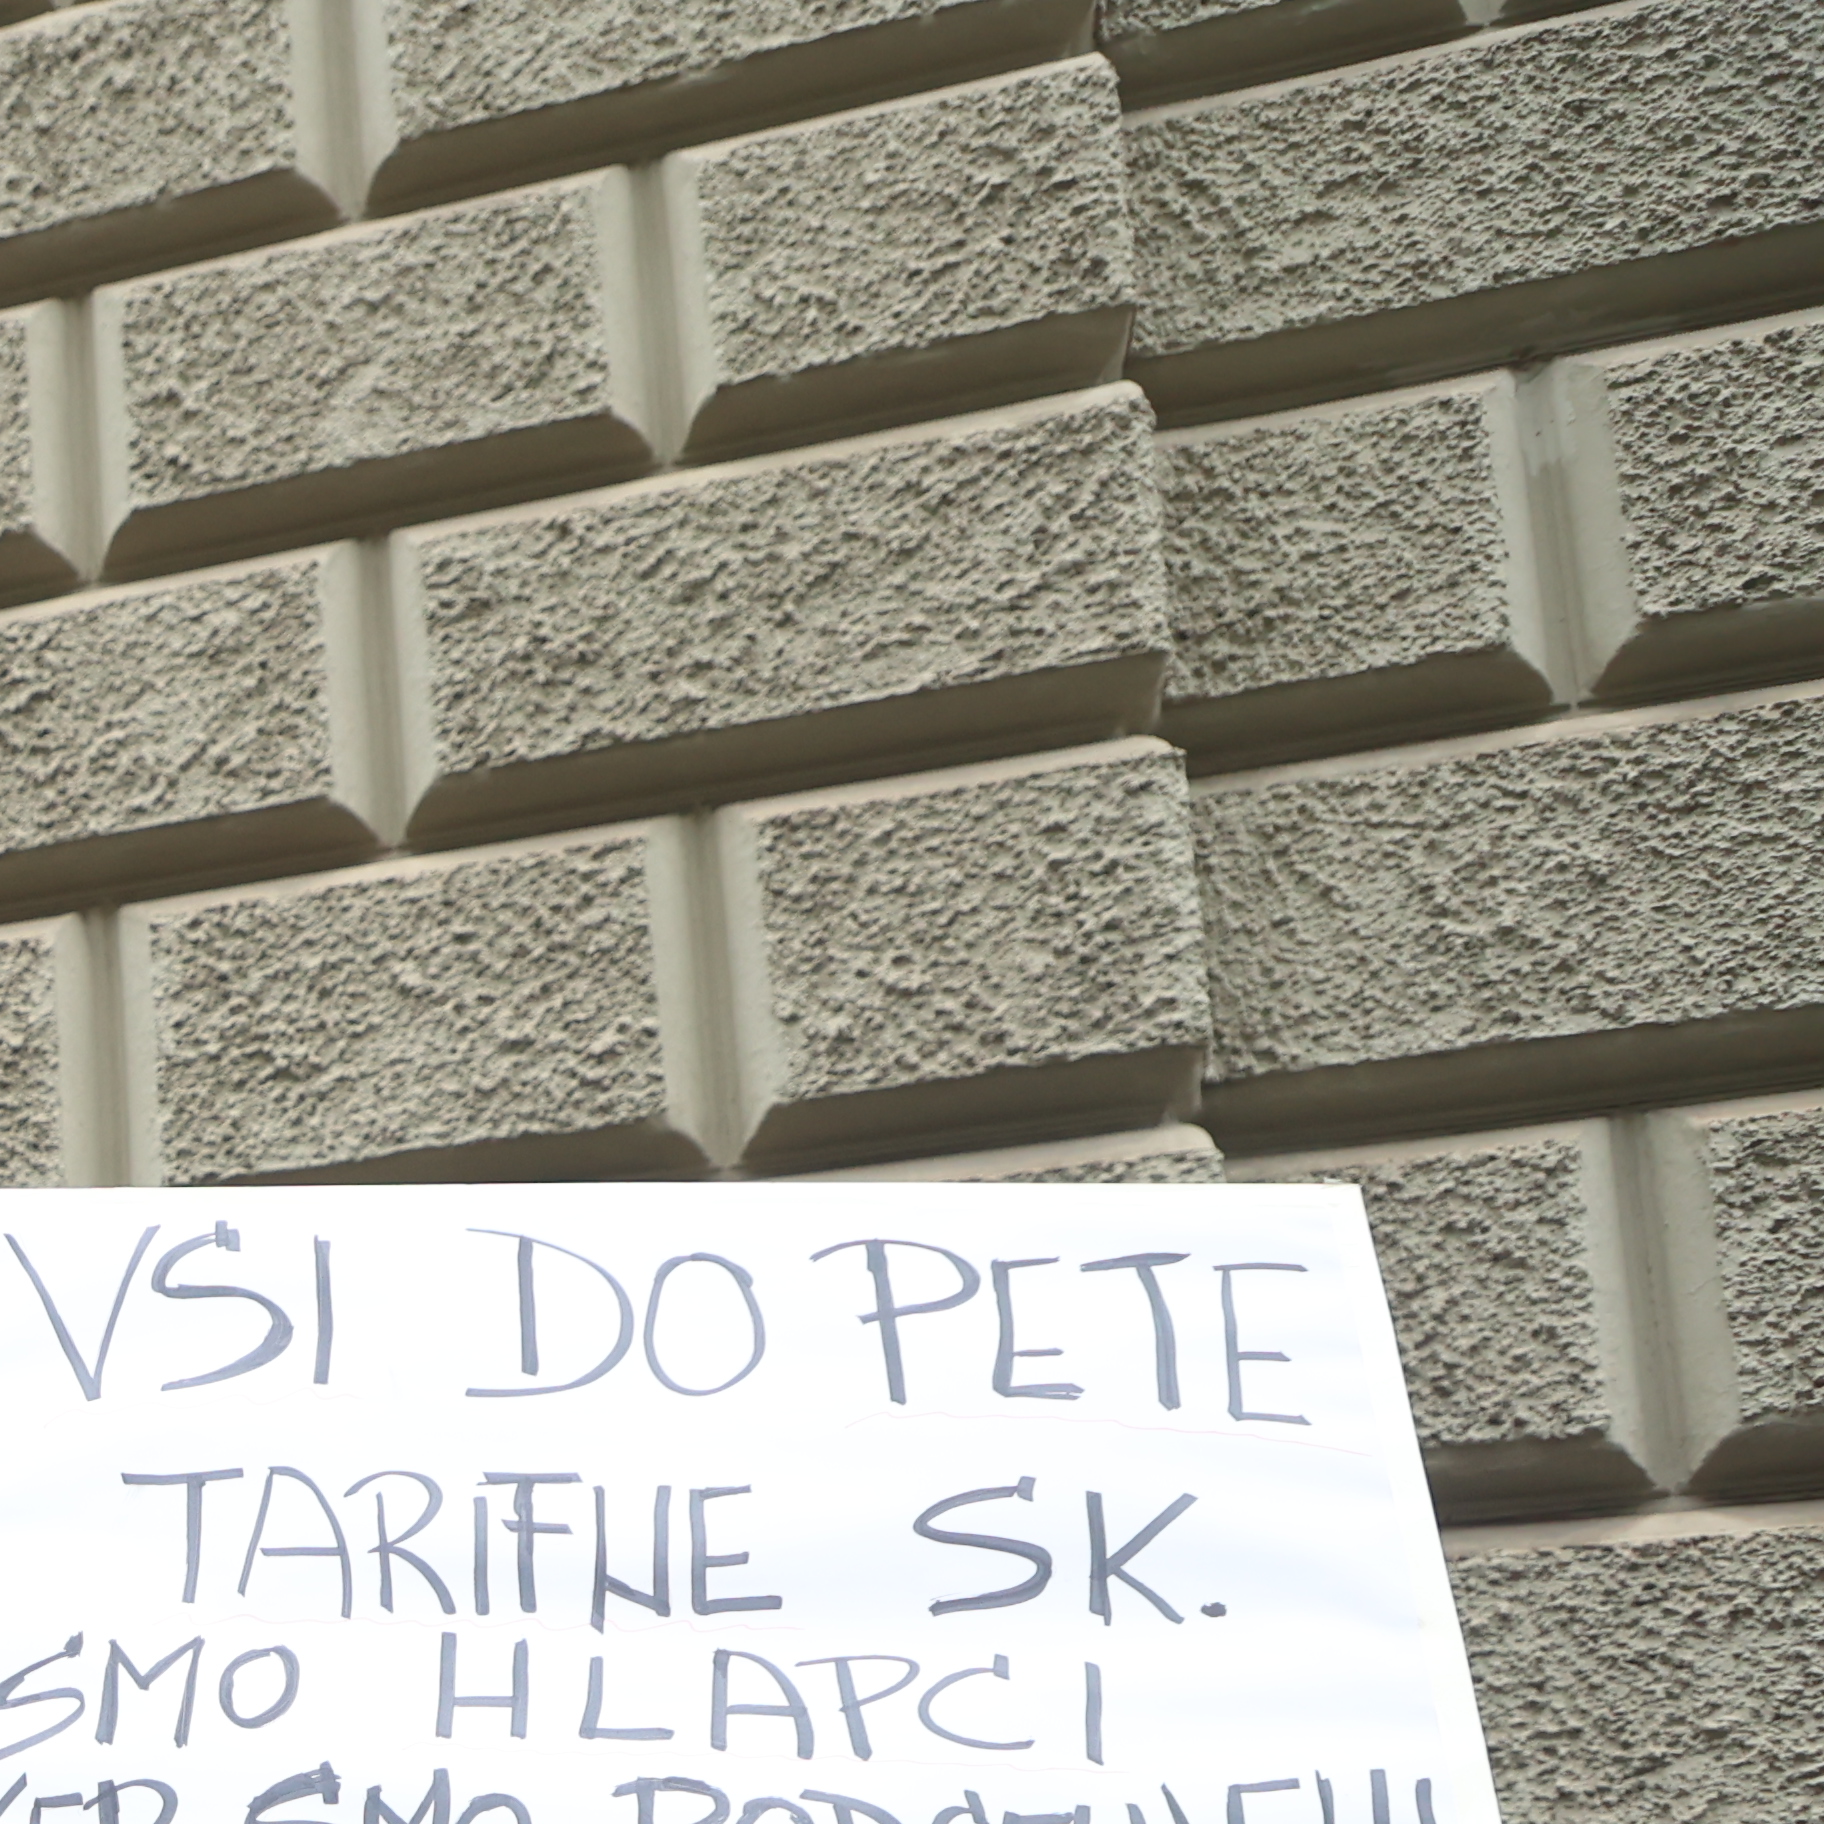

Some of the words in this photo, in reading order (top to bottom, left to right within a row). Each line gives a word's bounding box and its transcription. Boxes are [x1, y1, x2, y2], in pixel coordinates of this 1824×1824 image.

[465, 1228, 766, 1397] DO
[809, 1238, 1312, 1426] PETE
[121, 1465, 782, 1634] TARIFNE
[913, 1475, 1227, 1627] SK.
